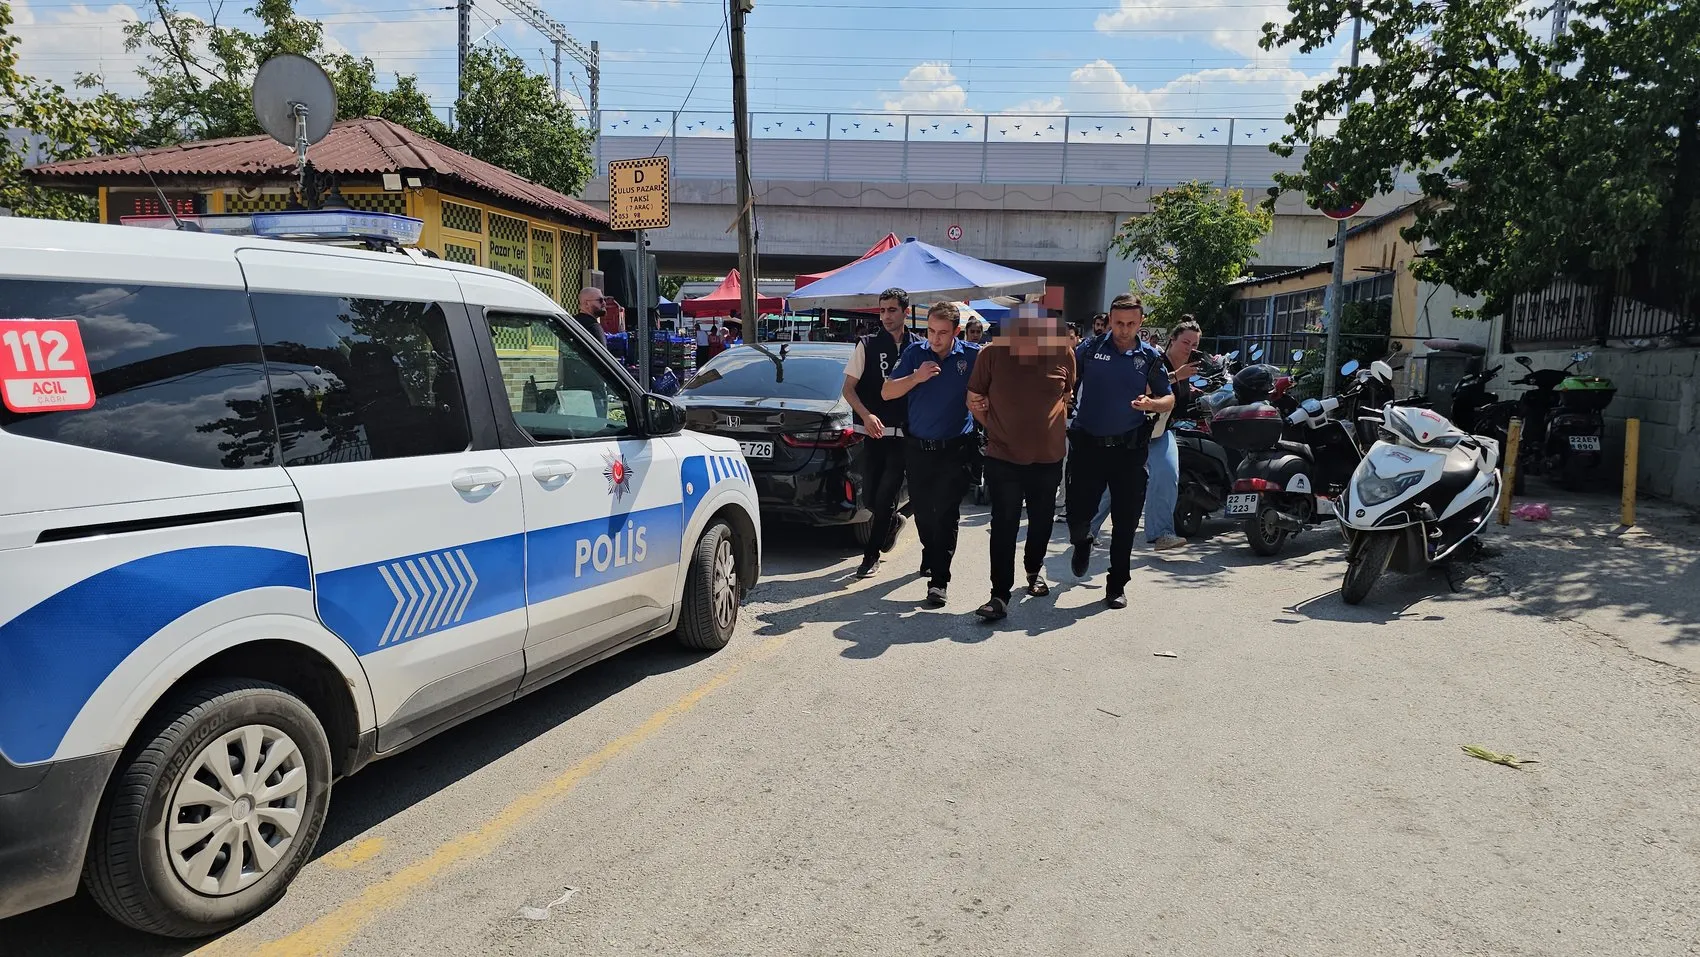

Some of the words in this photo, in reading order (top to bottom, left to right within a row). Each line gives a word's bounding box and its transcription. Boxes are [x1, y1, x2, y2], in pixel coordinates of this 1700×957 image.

[634, 170, 644, 183] D
[629, 194, 649, 202] TAKSİ
[489, 240, 510, 257] Pazar
[512, 245, 526, 260] Yeri
[2, 330, 76, 371] 112
[32, 381, 67, 395] ACİL
[749, 443, 771, 456] 726
[1228, 496, 1239, 504] 22
[1232, 505, 1249, 513] 223
[575, 519, 647, 578] POLİS
